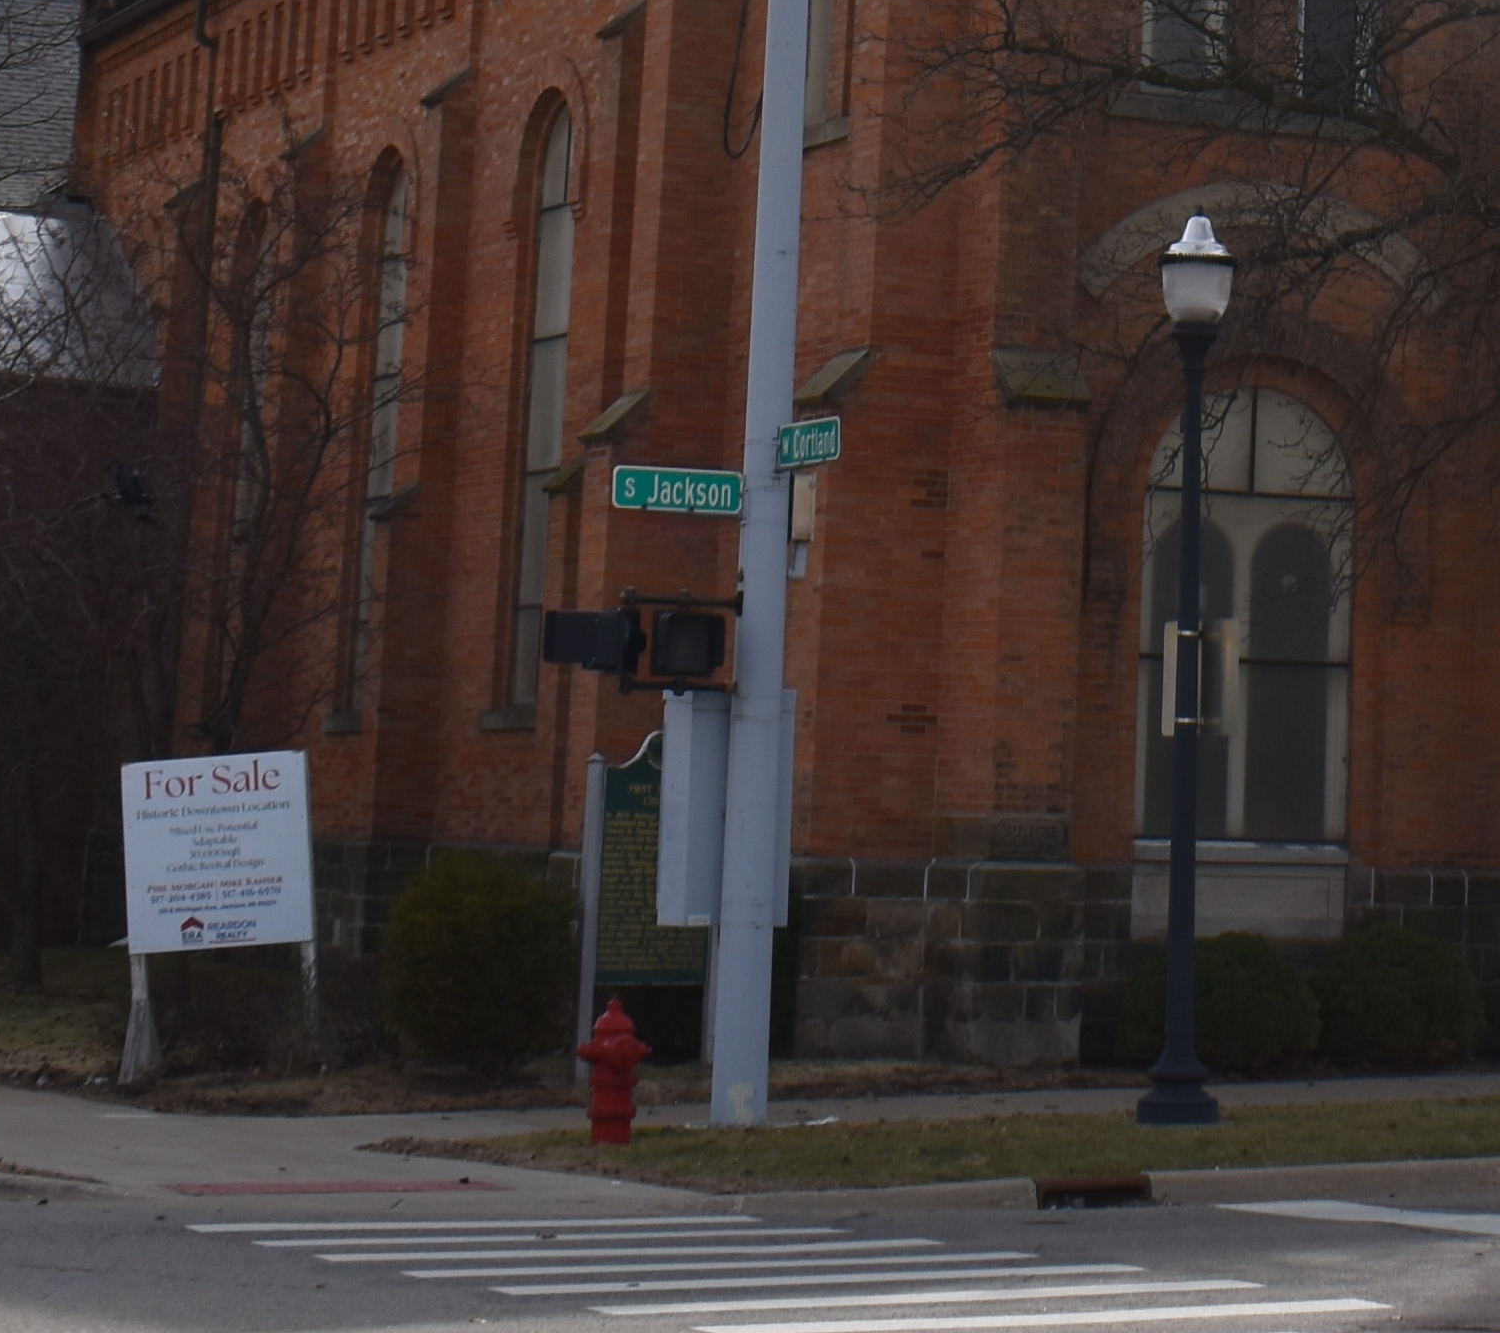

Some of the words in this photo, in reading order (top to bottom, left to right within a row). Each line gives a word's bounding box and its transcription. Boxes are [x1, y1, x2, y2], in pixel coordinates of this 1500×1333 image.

[793, 424, 836, 459] Cortland
[625, 476, 636, 498] S
[647, 473, 732, 507] Jackson
[144, 770, 203, 800] For
[211, 758, 281, 795] Sale
[137, 808, 180, 820] Historic
[181, 803, 240, 817] Downtown
[241, 800, 290, 813] Location
[217, 819, 258, 832] Potential
[192, 835, 238, 848] Adaptable
[167, 861, 198, 873] Gothic
[200, 859, 232, 870] Revival
[233, 857, 265, 870] Design
[220, 878, 242, 887] MIKE
[207, 919, 257, 931] REARDON
[182, 931, 203, 939] ERA
[216, 930, 248, 939] REALTY
